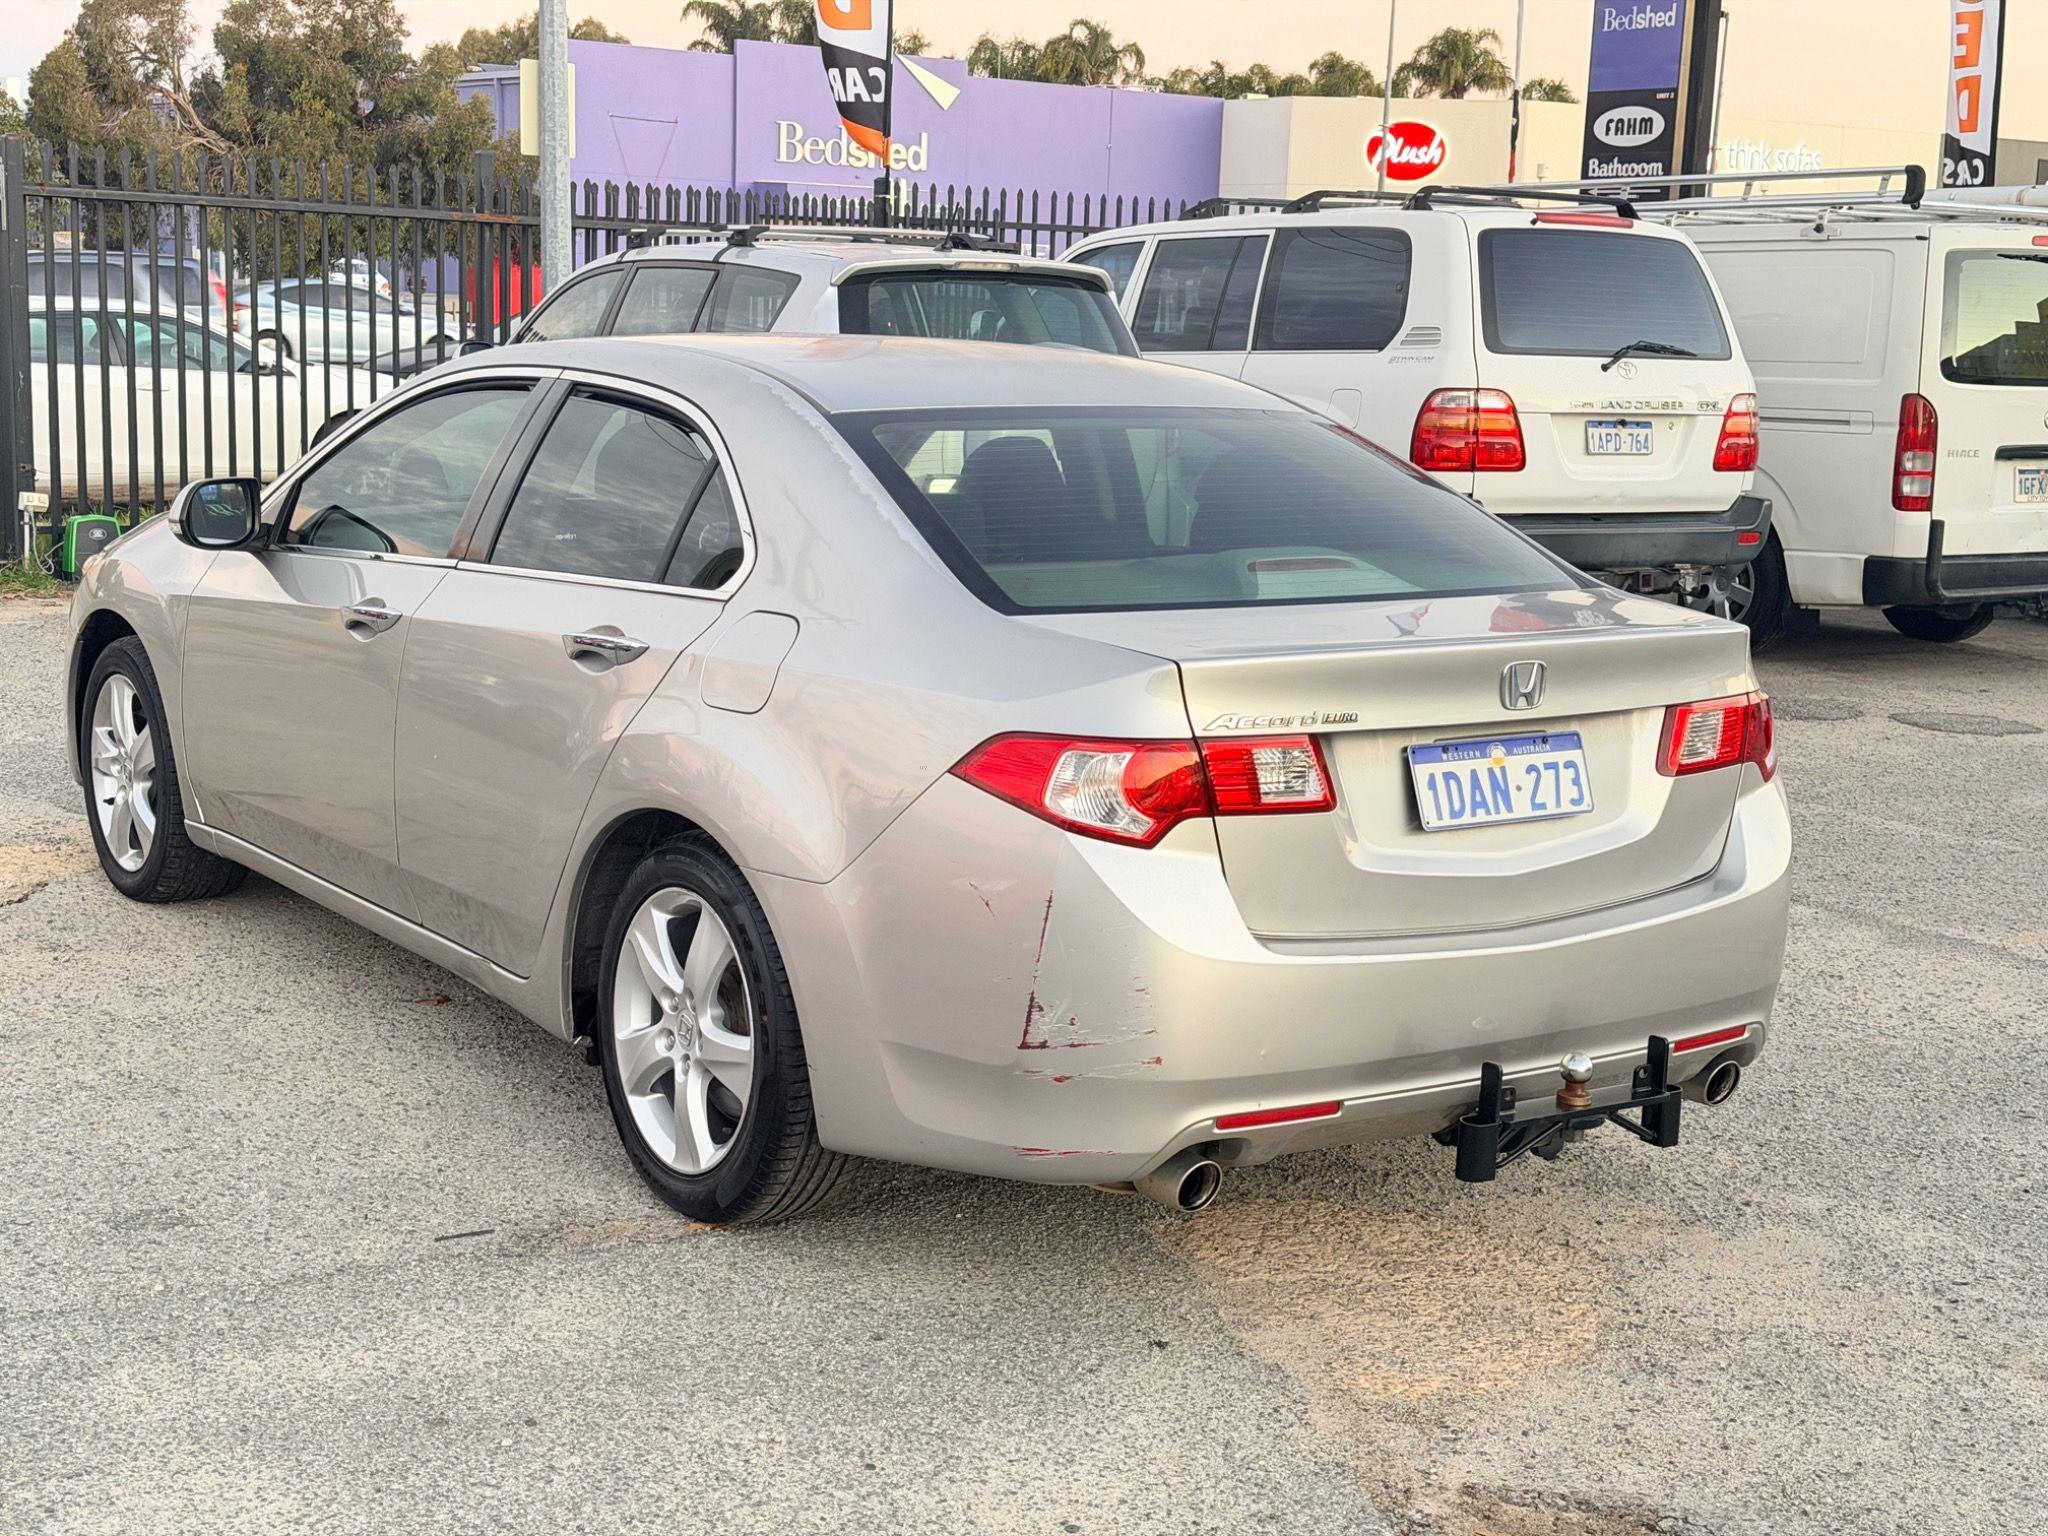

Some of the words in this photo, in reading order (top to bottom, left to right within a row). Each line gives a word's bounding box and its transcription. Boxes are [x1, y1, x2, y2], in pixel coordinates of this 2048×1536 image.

[1602, 3, 1677, 32] Bedshed
[1605, 117, 1654, 137] FAHM
[1371, 130, 1442, 172] Plush
[1726, 139, 1773, 171] think
[1776, 143, 1823, 173] sofas
[1588, 156, 1664, 177] Bathroom
[1947, 449, 1980, 458] HIACE
[1322, 710, 1359, 725] EURO
[1513, 744, 1552, 755] AUSTRALIA
